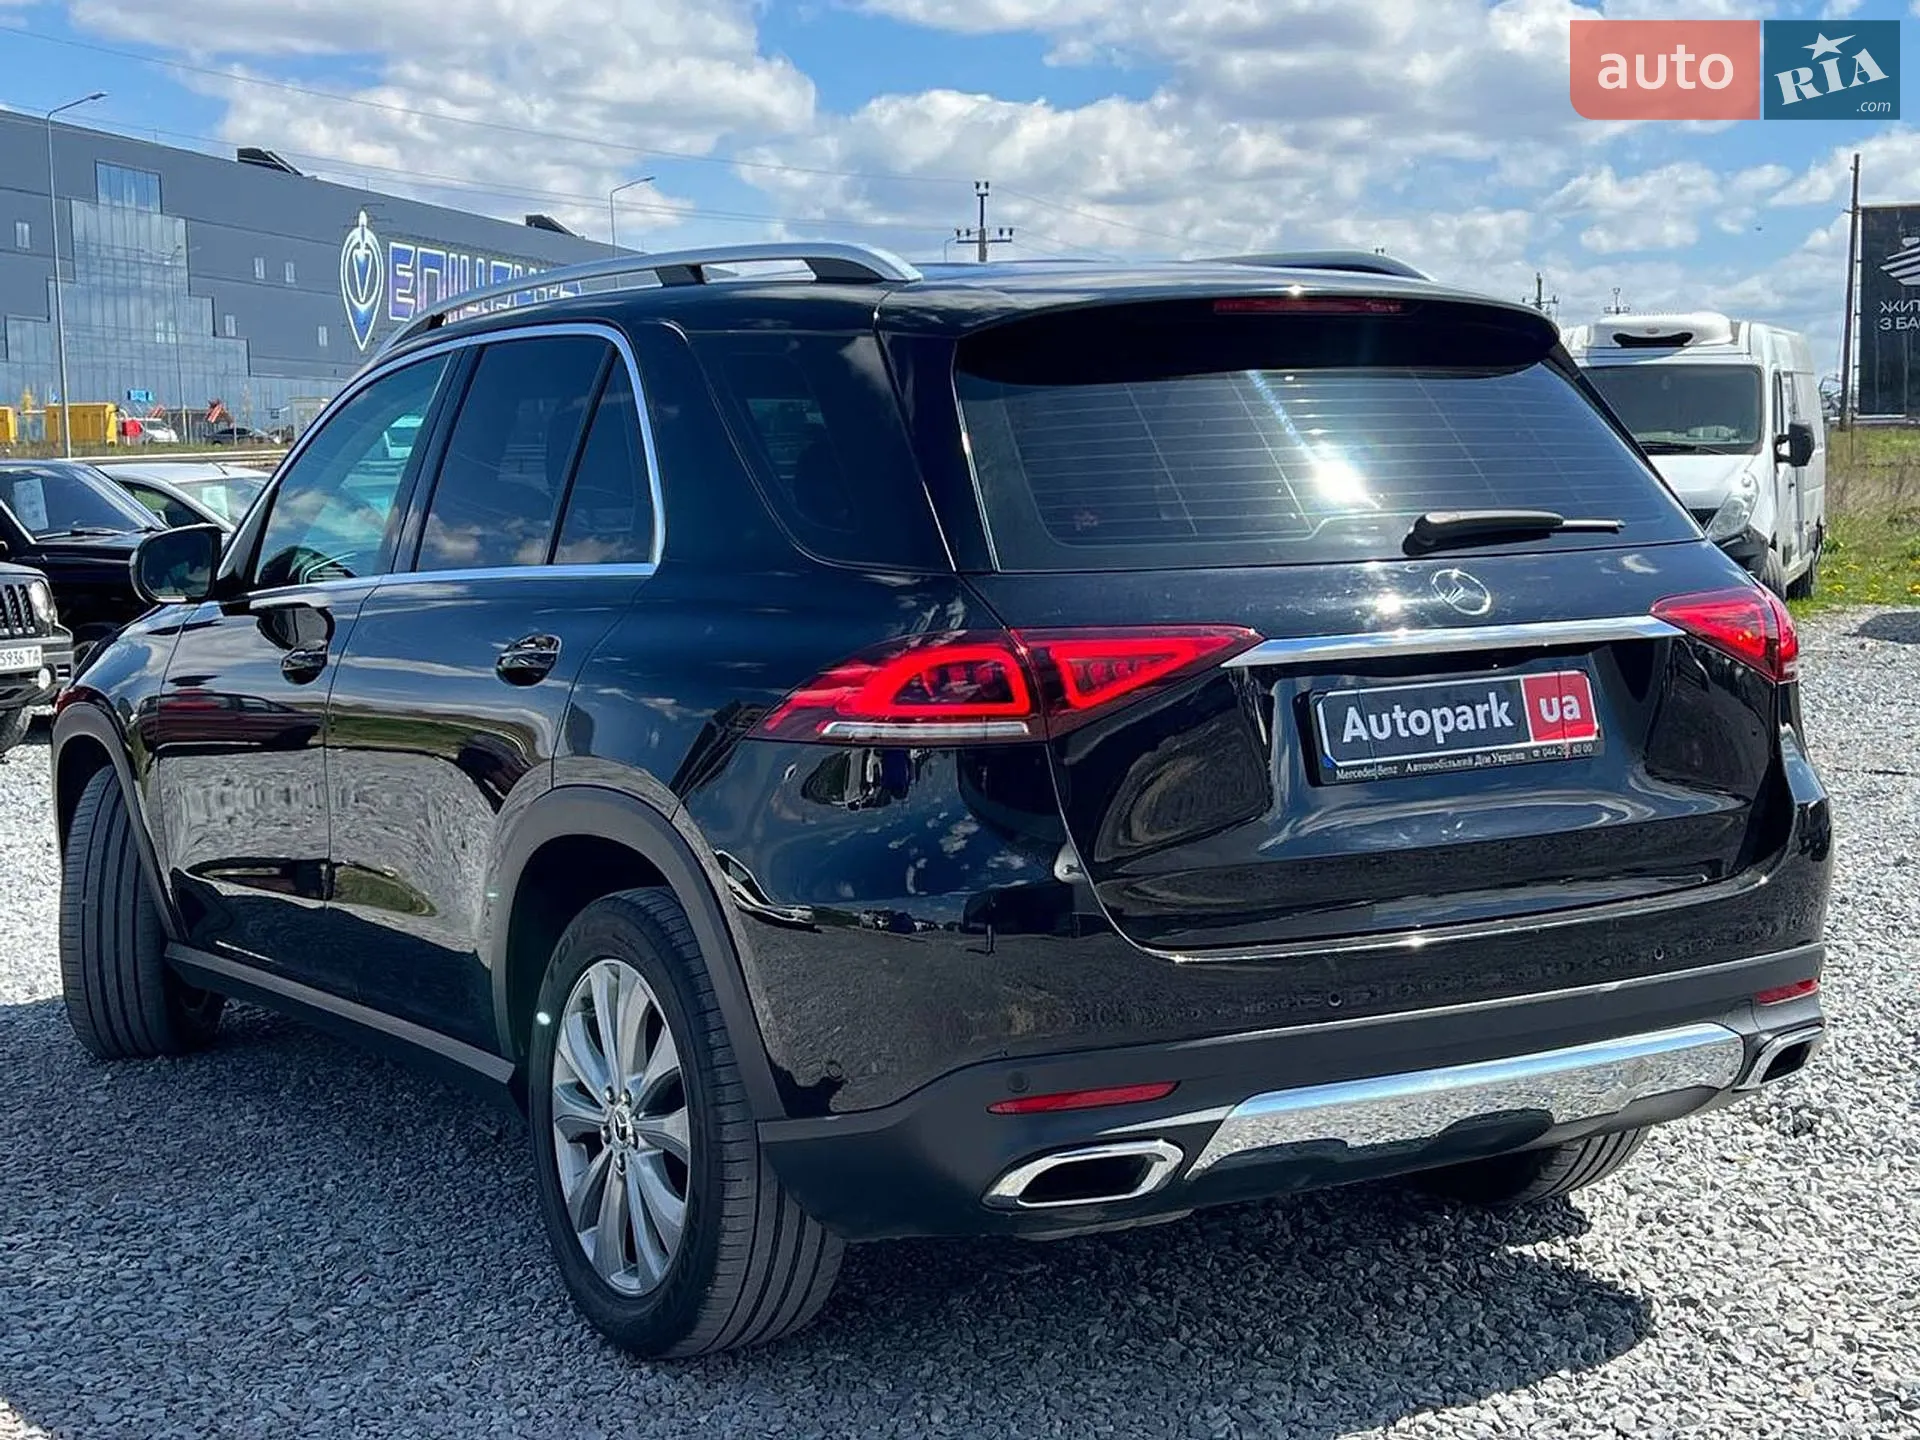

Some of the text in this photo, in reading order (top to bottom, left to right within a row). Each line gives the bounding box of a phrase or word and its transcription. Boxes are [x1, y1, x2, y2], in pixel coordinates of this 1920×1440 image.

[1895, 316, 1920, 330] БА
[1342, 692, 1582, 744] Autopark ua
